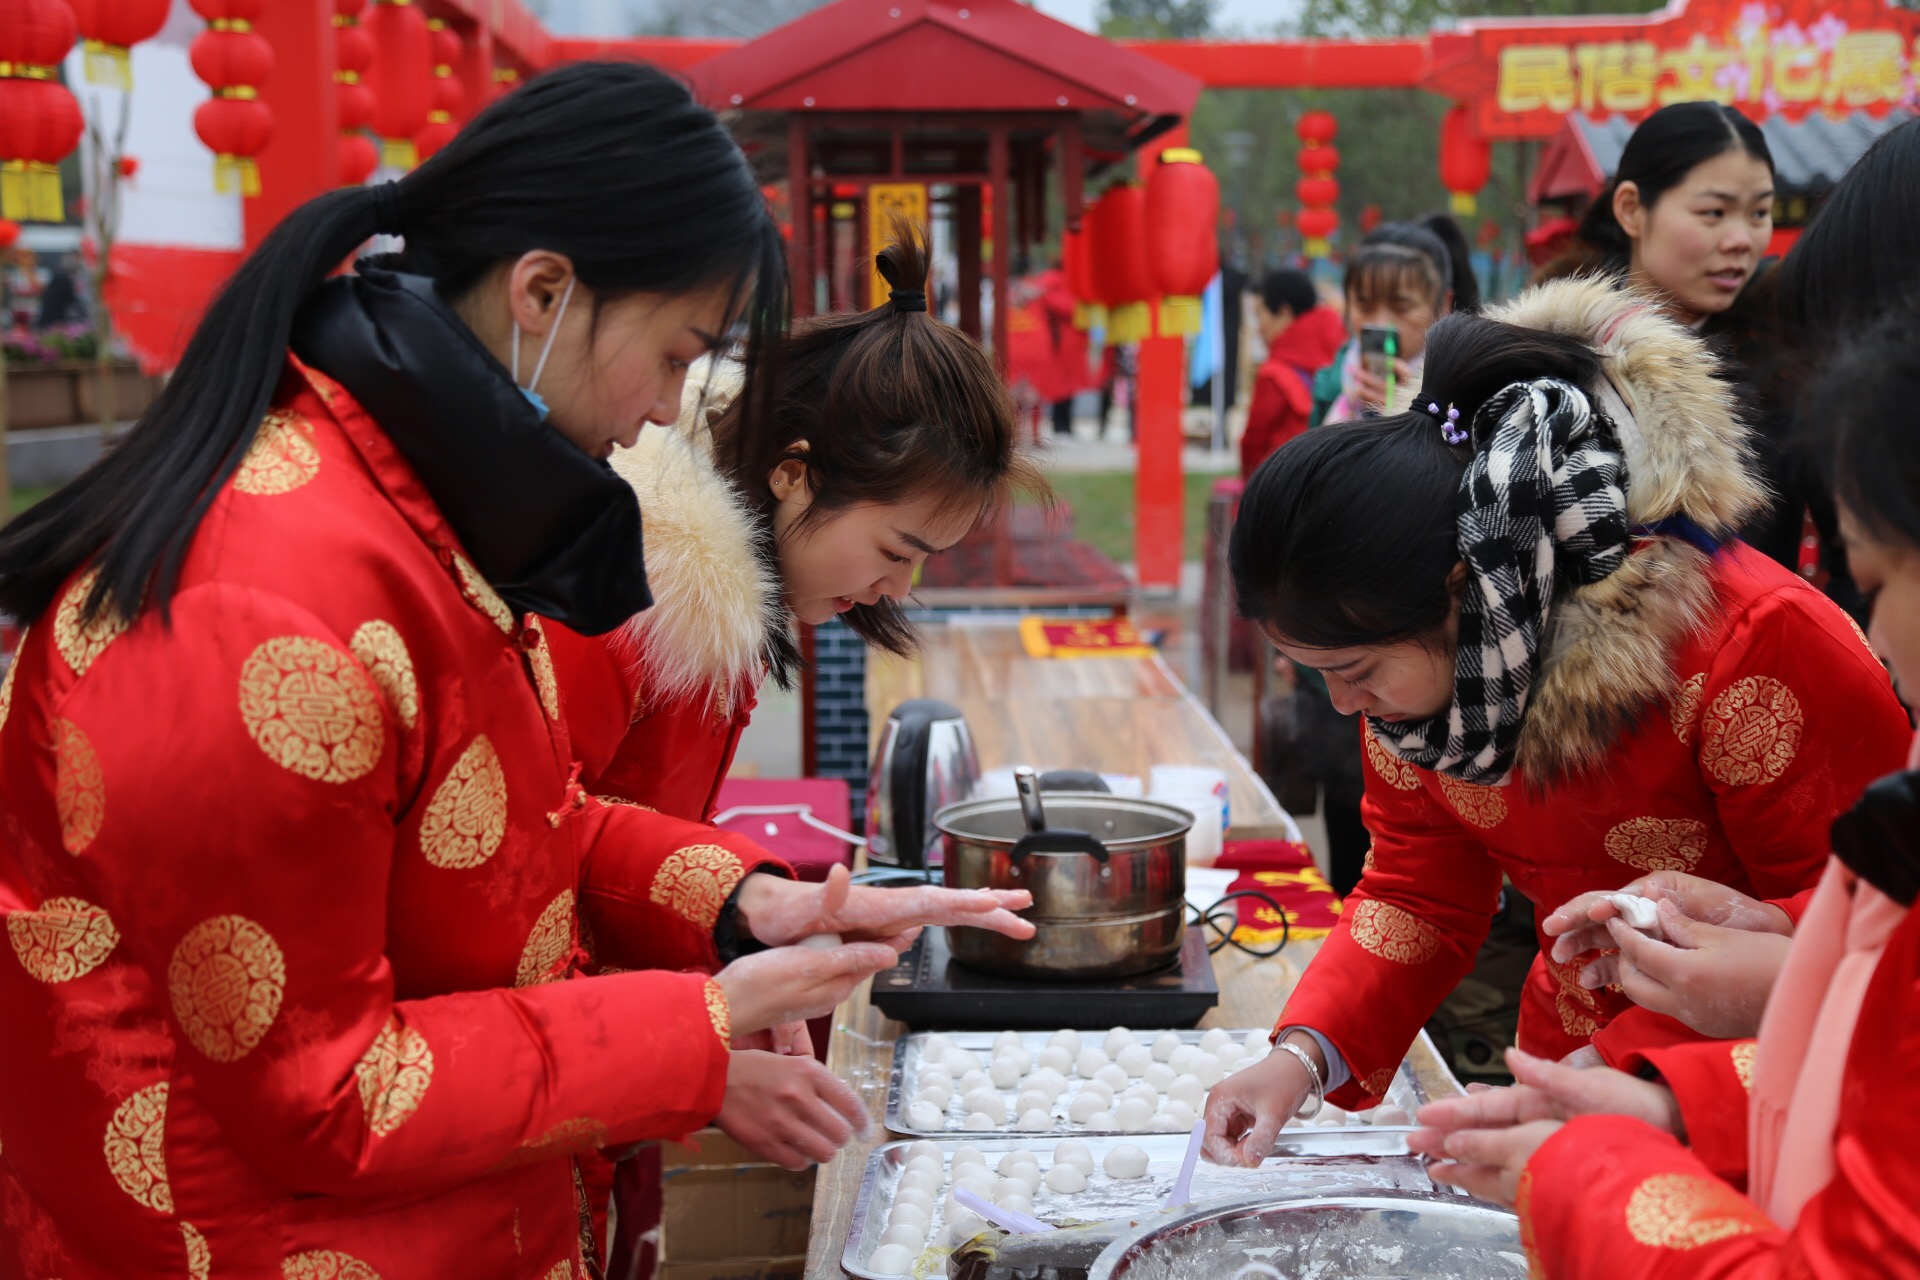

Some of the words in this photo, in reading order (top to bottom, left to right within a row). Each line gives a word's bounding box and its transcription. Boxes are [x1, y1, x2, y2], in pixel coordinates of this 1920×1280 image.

[1499, 29, 1920, 112] 民俗文化展
